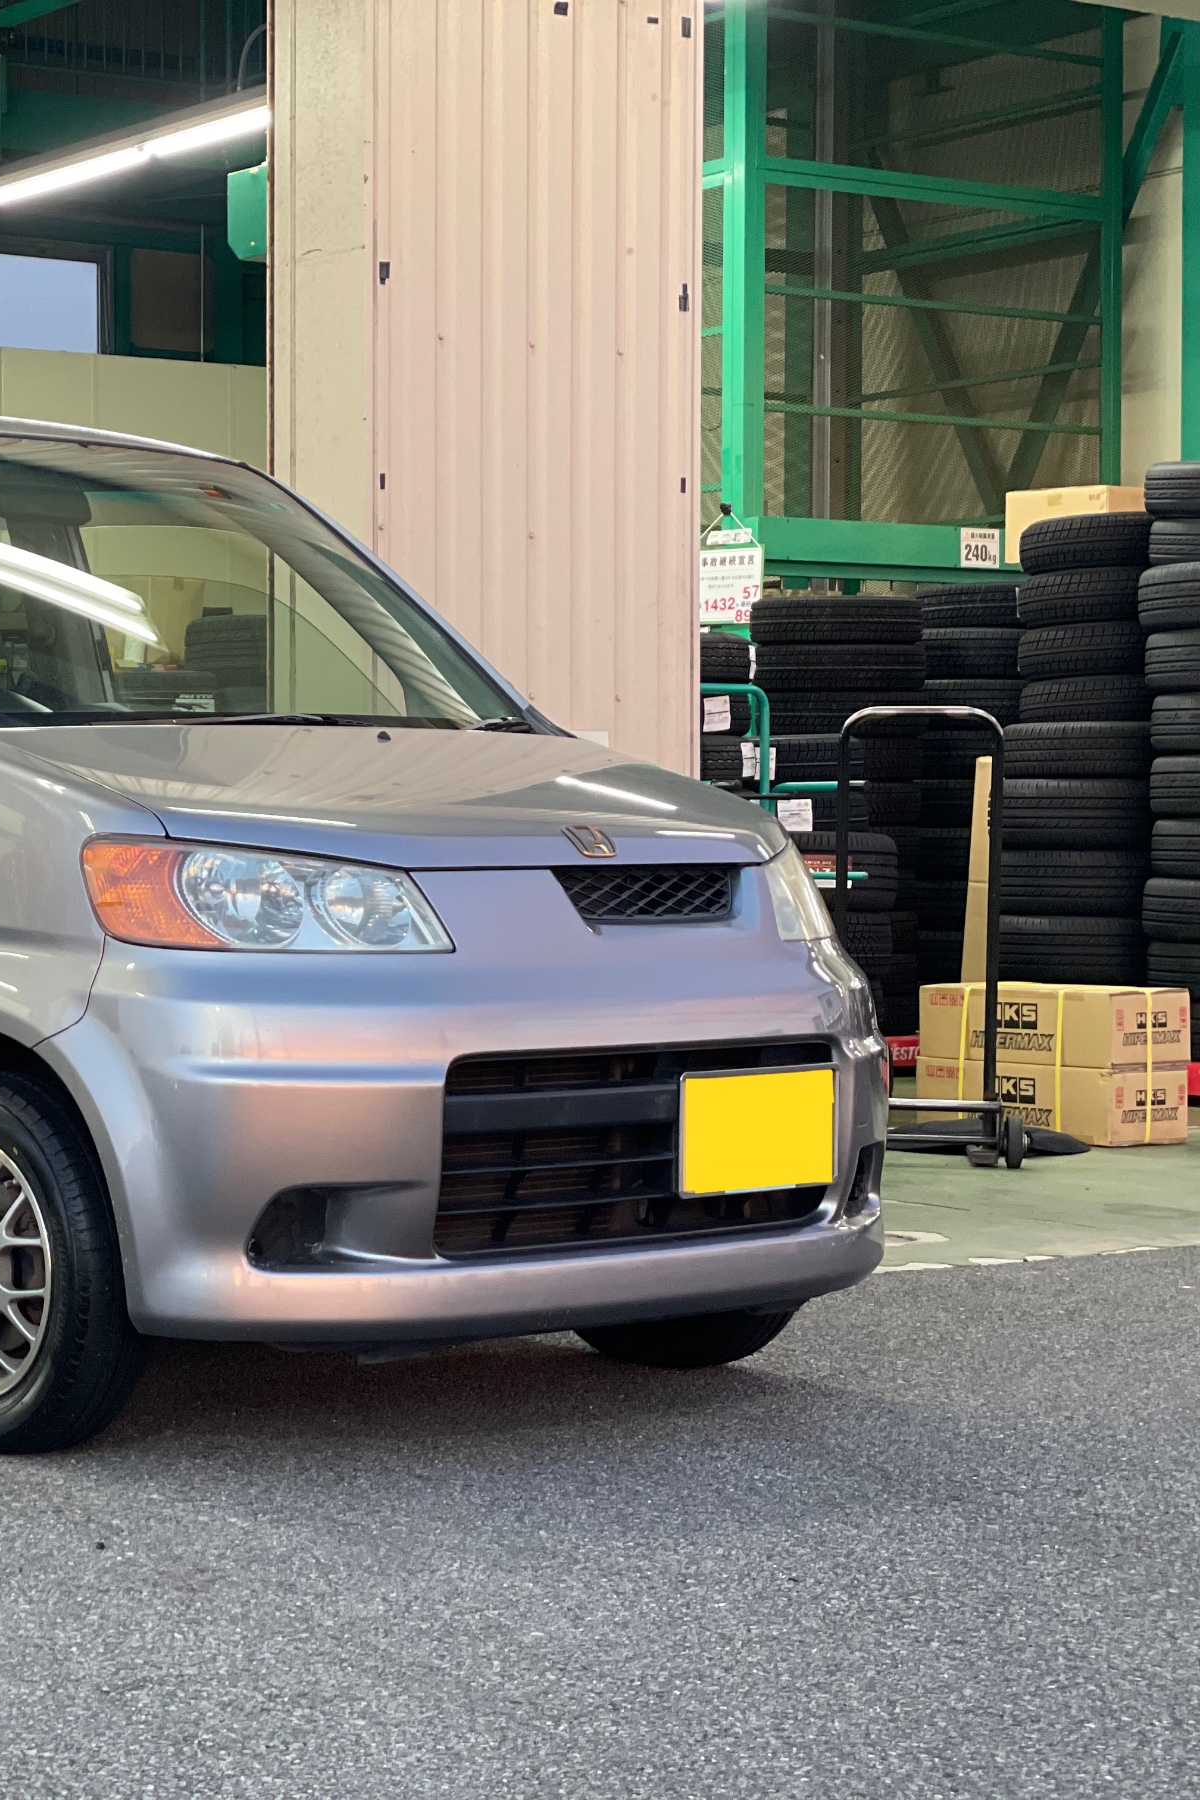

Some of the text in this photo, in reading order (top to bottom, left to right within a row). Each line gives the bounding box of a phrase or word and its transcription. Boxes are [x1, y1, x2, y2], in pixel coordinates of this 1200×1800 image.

[743, 585, 759, 599] 57
[704, 597, 735, 611] 1432
[970, 1030, 1054, 1051] HERMAX
